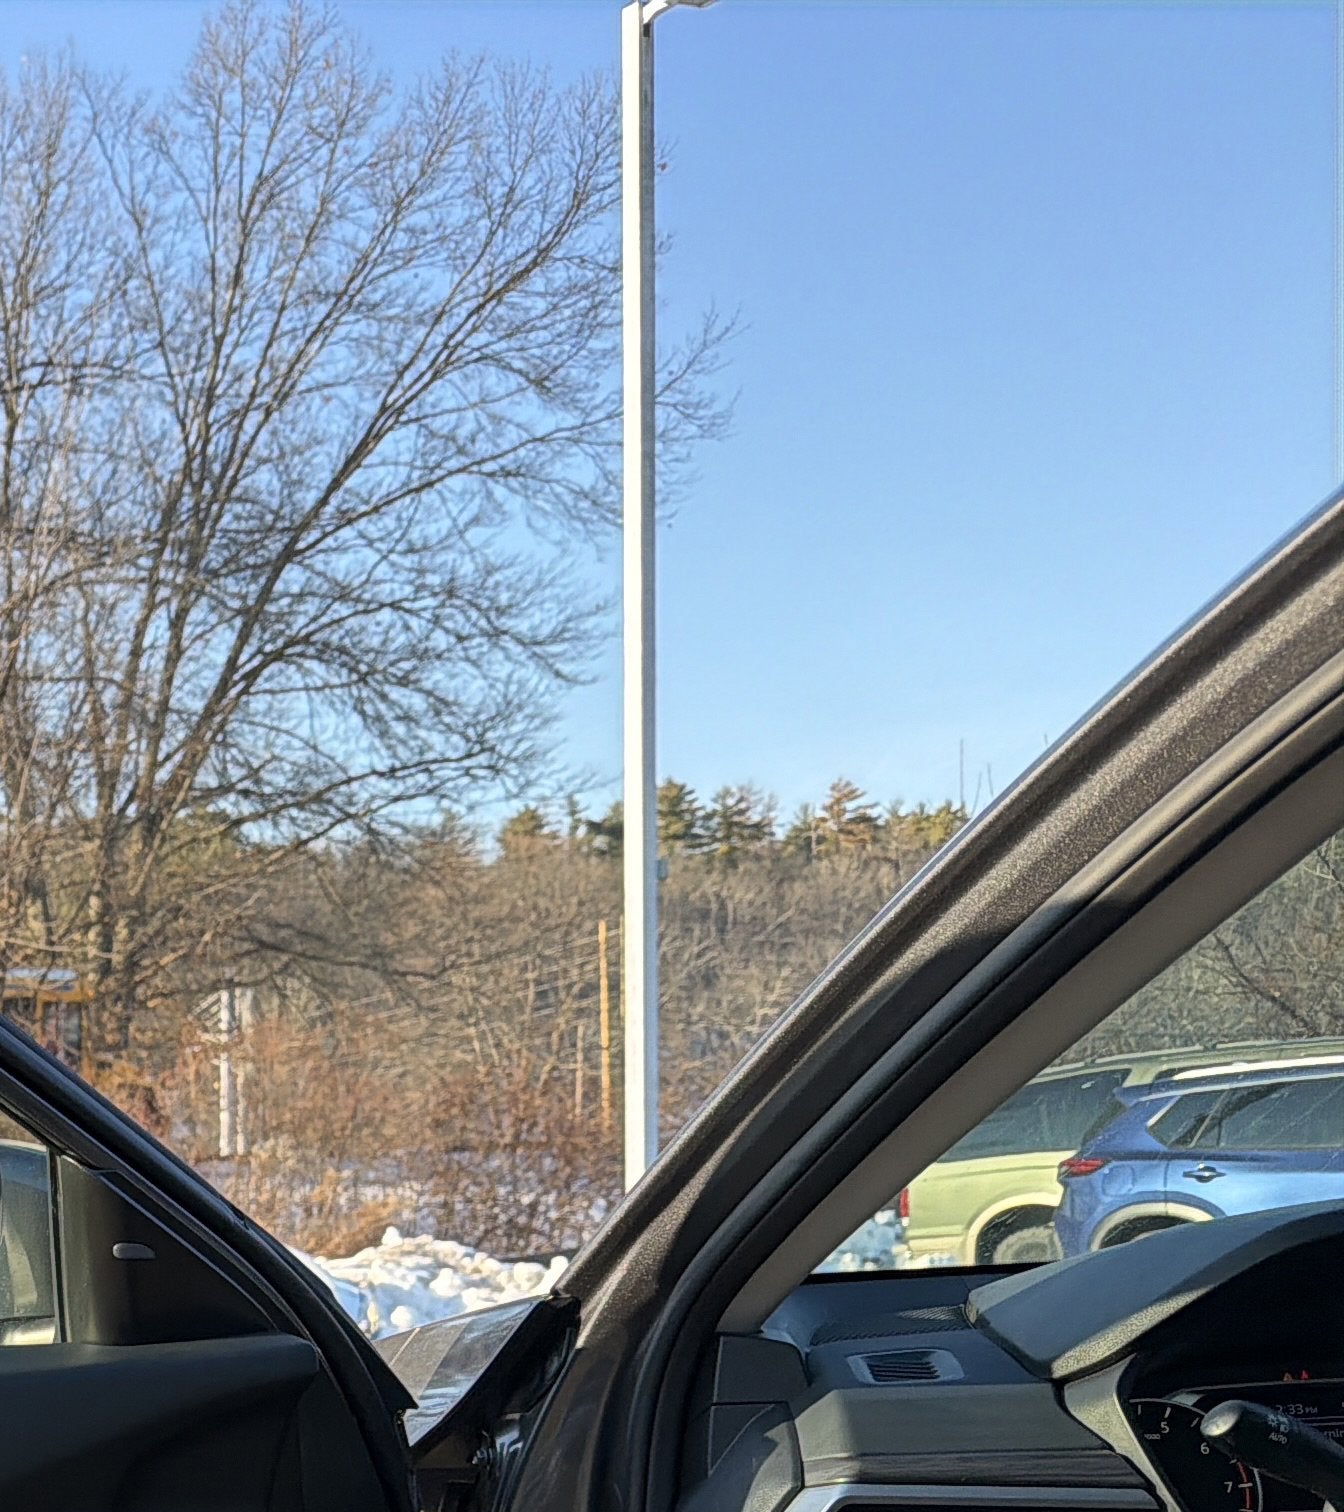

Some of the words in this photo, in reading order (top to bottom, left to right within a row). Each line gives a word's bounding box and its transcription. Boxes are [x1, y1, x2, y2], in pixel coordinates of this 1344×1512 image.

[1160, 1422, 1170, 1434] 5
[1268, 1432, 1288, 1445] AUTO
[1200, 1441, 1210, 1455] 6
[1224, 1481, 1233, 1493] 7
